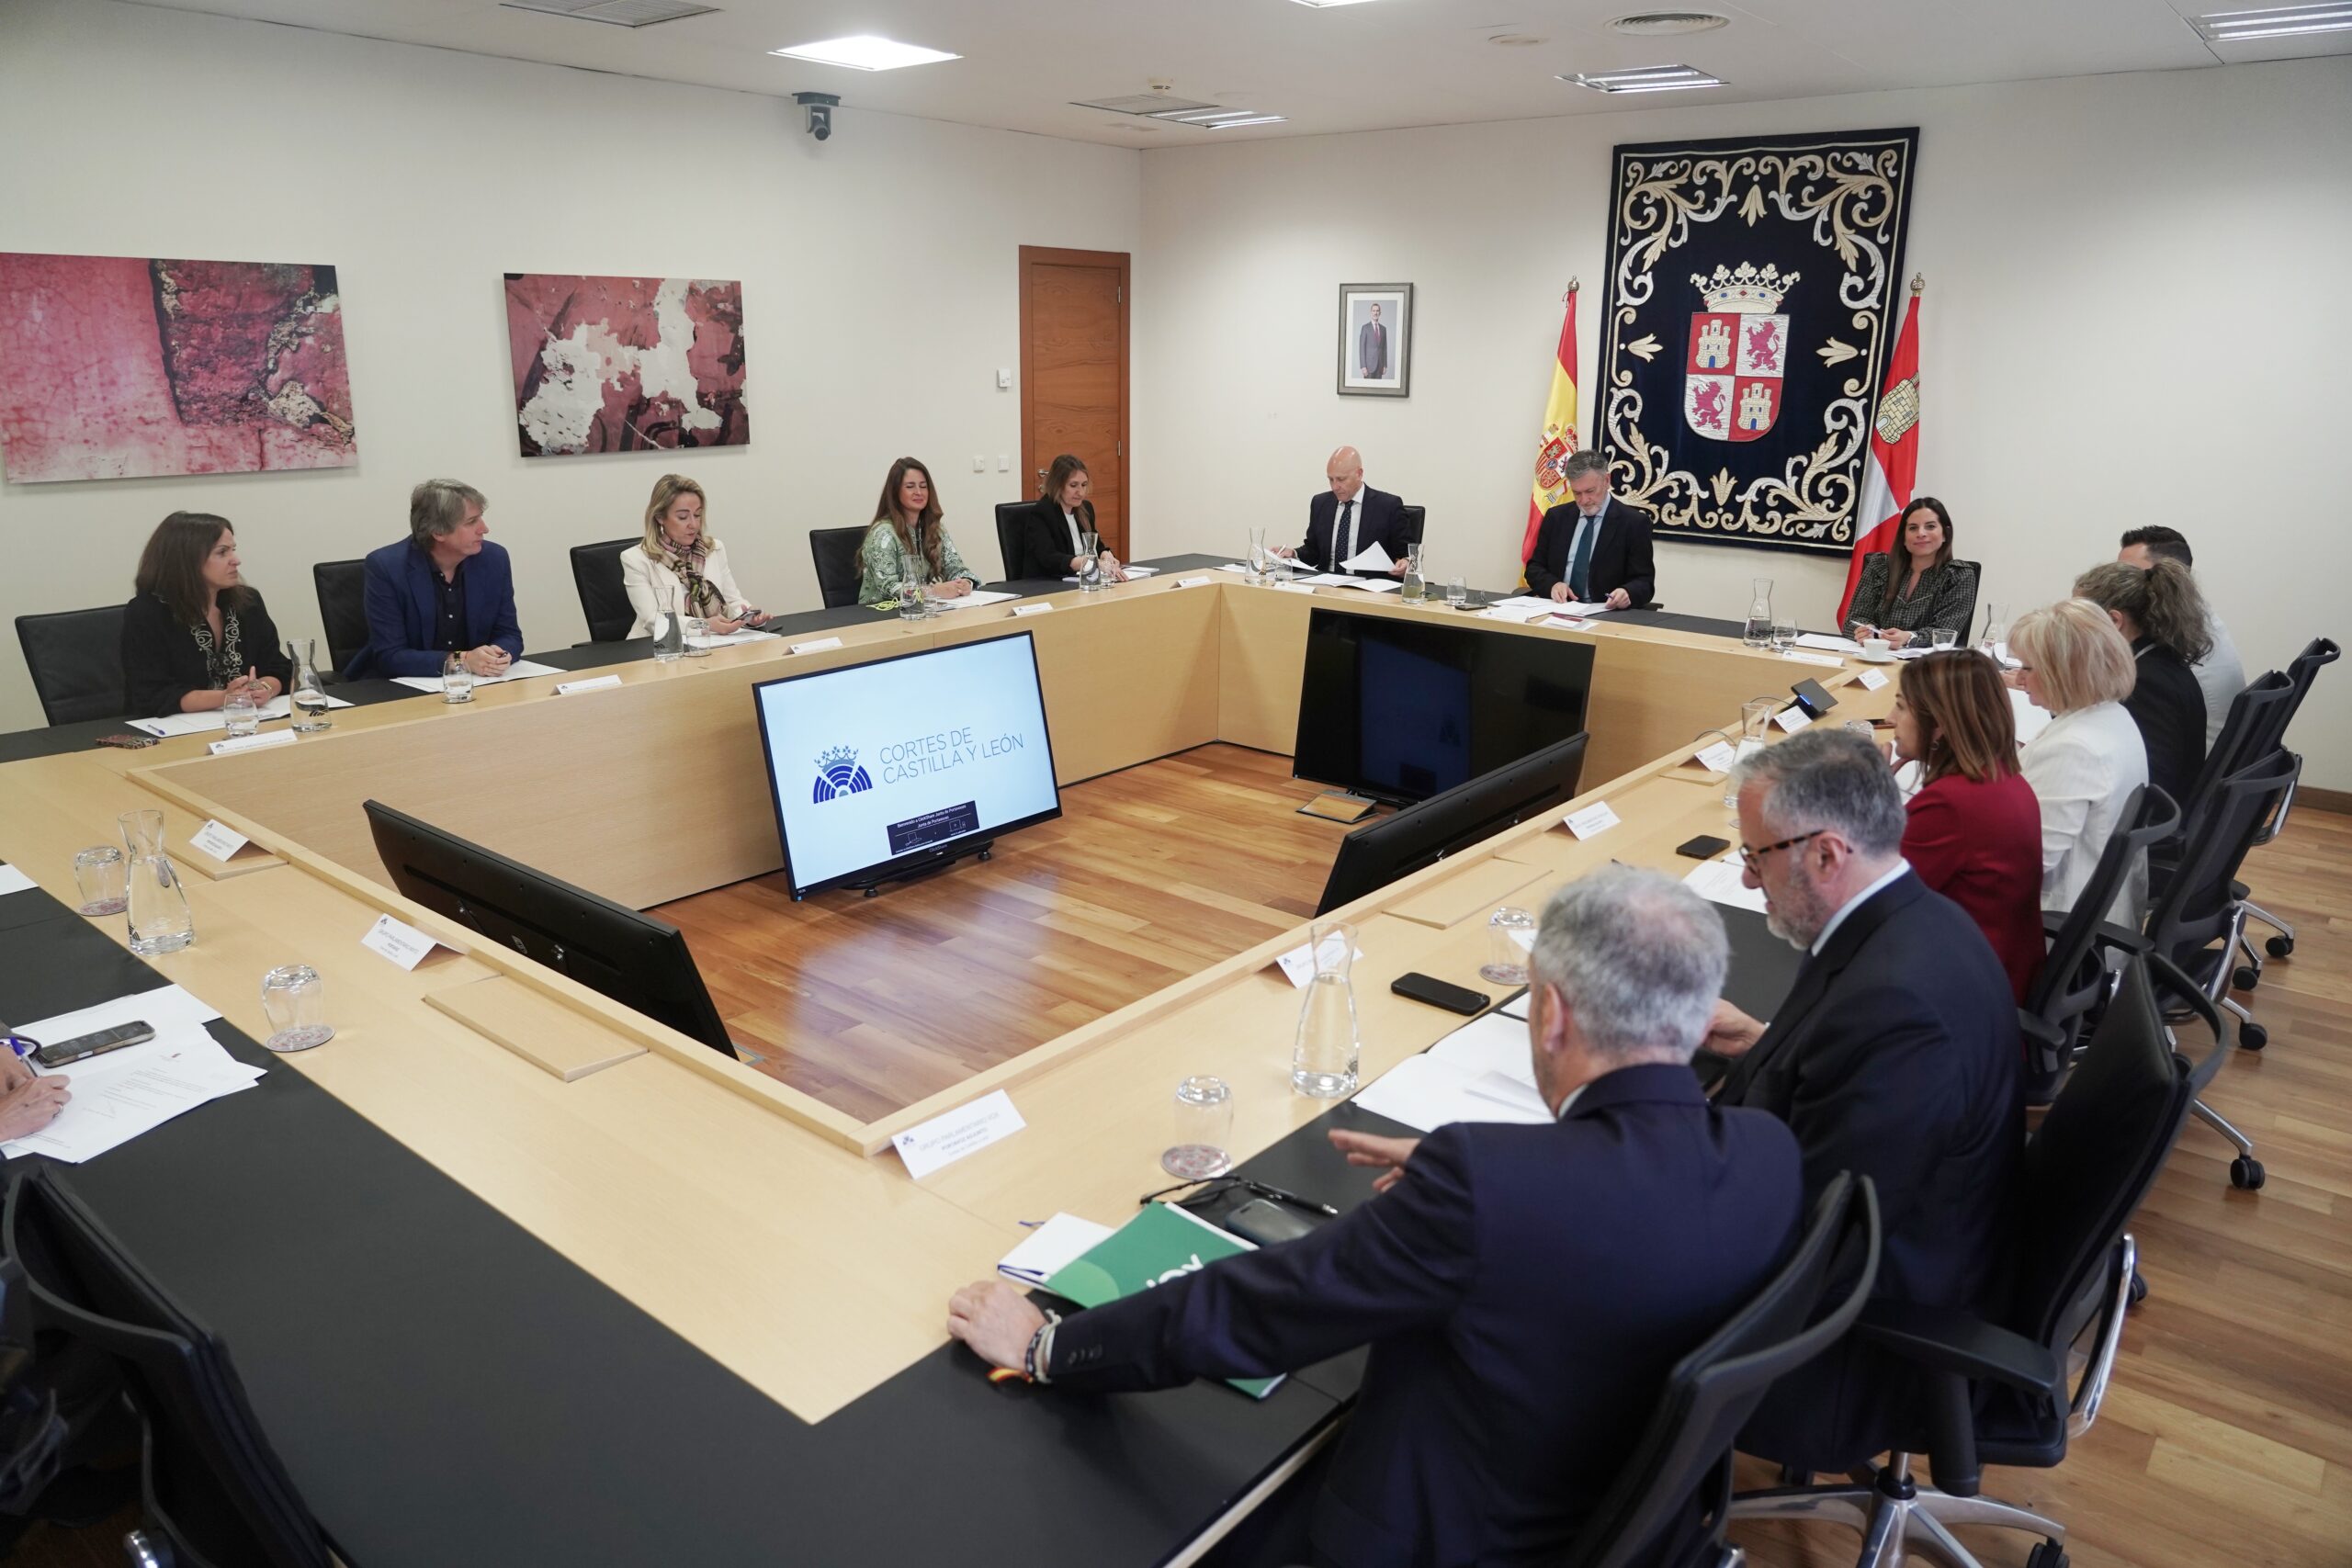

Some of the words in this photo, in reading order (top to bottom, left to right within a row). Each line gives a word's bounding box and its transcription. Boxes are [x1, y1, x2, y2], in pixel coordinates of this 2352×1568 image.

[879, 733, 947, 764] CORTES
[950, 727, 974, 748] DE
[883, 750, 965, 784] CASTILLA
[966, 745, 977, 761] Y
[981, 733, 1024, 759] LEÓN
